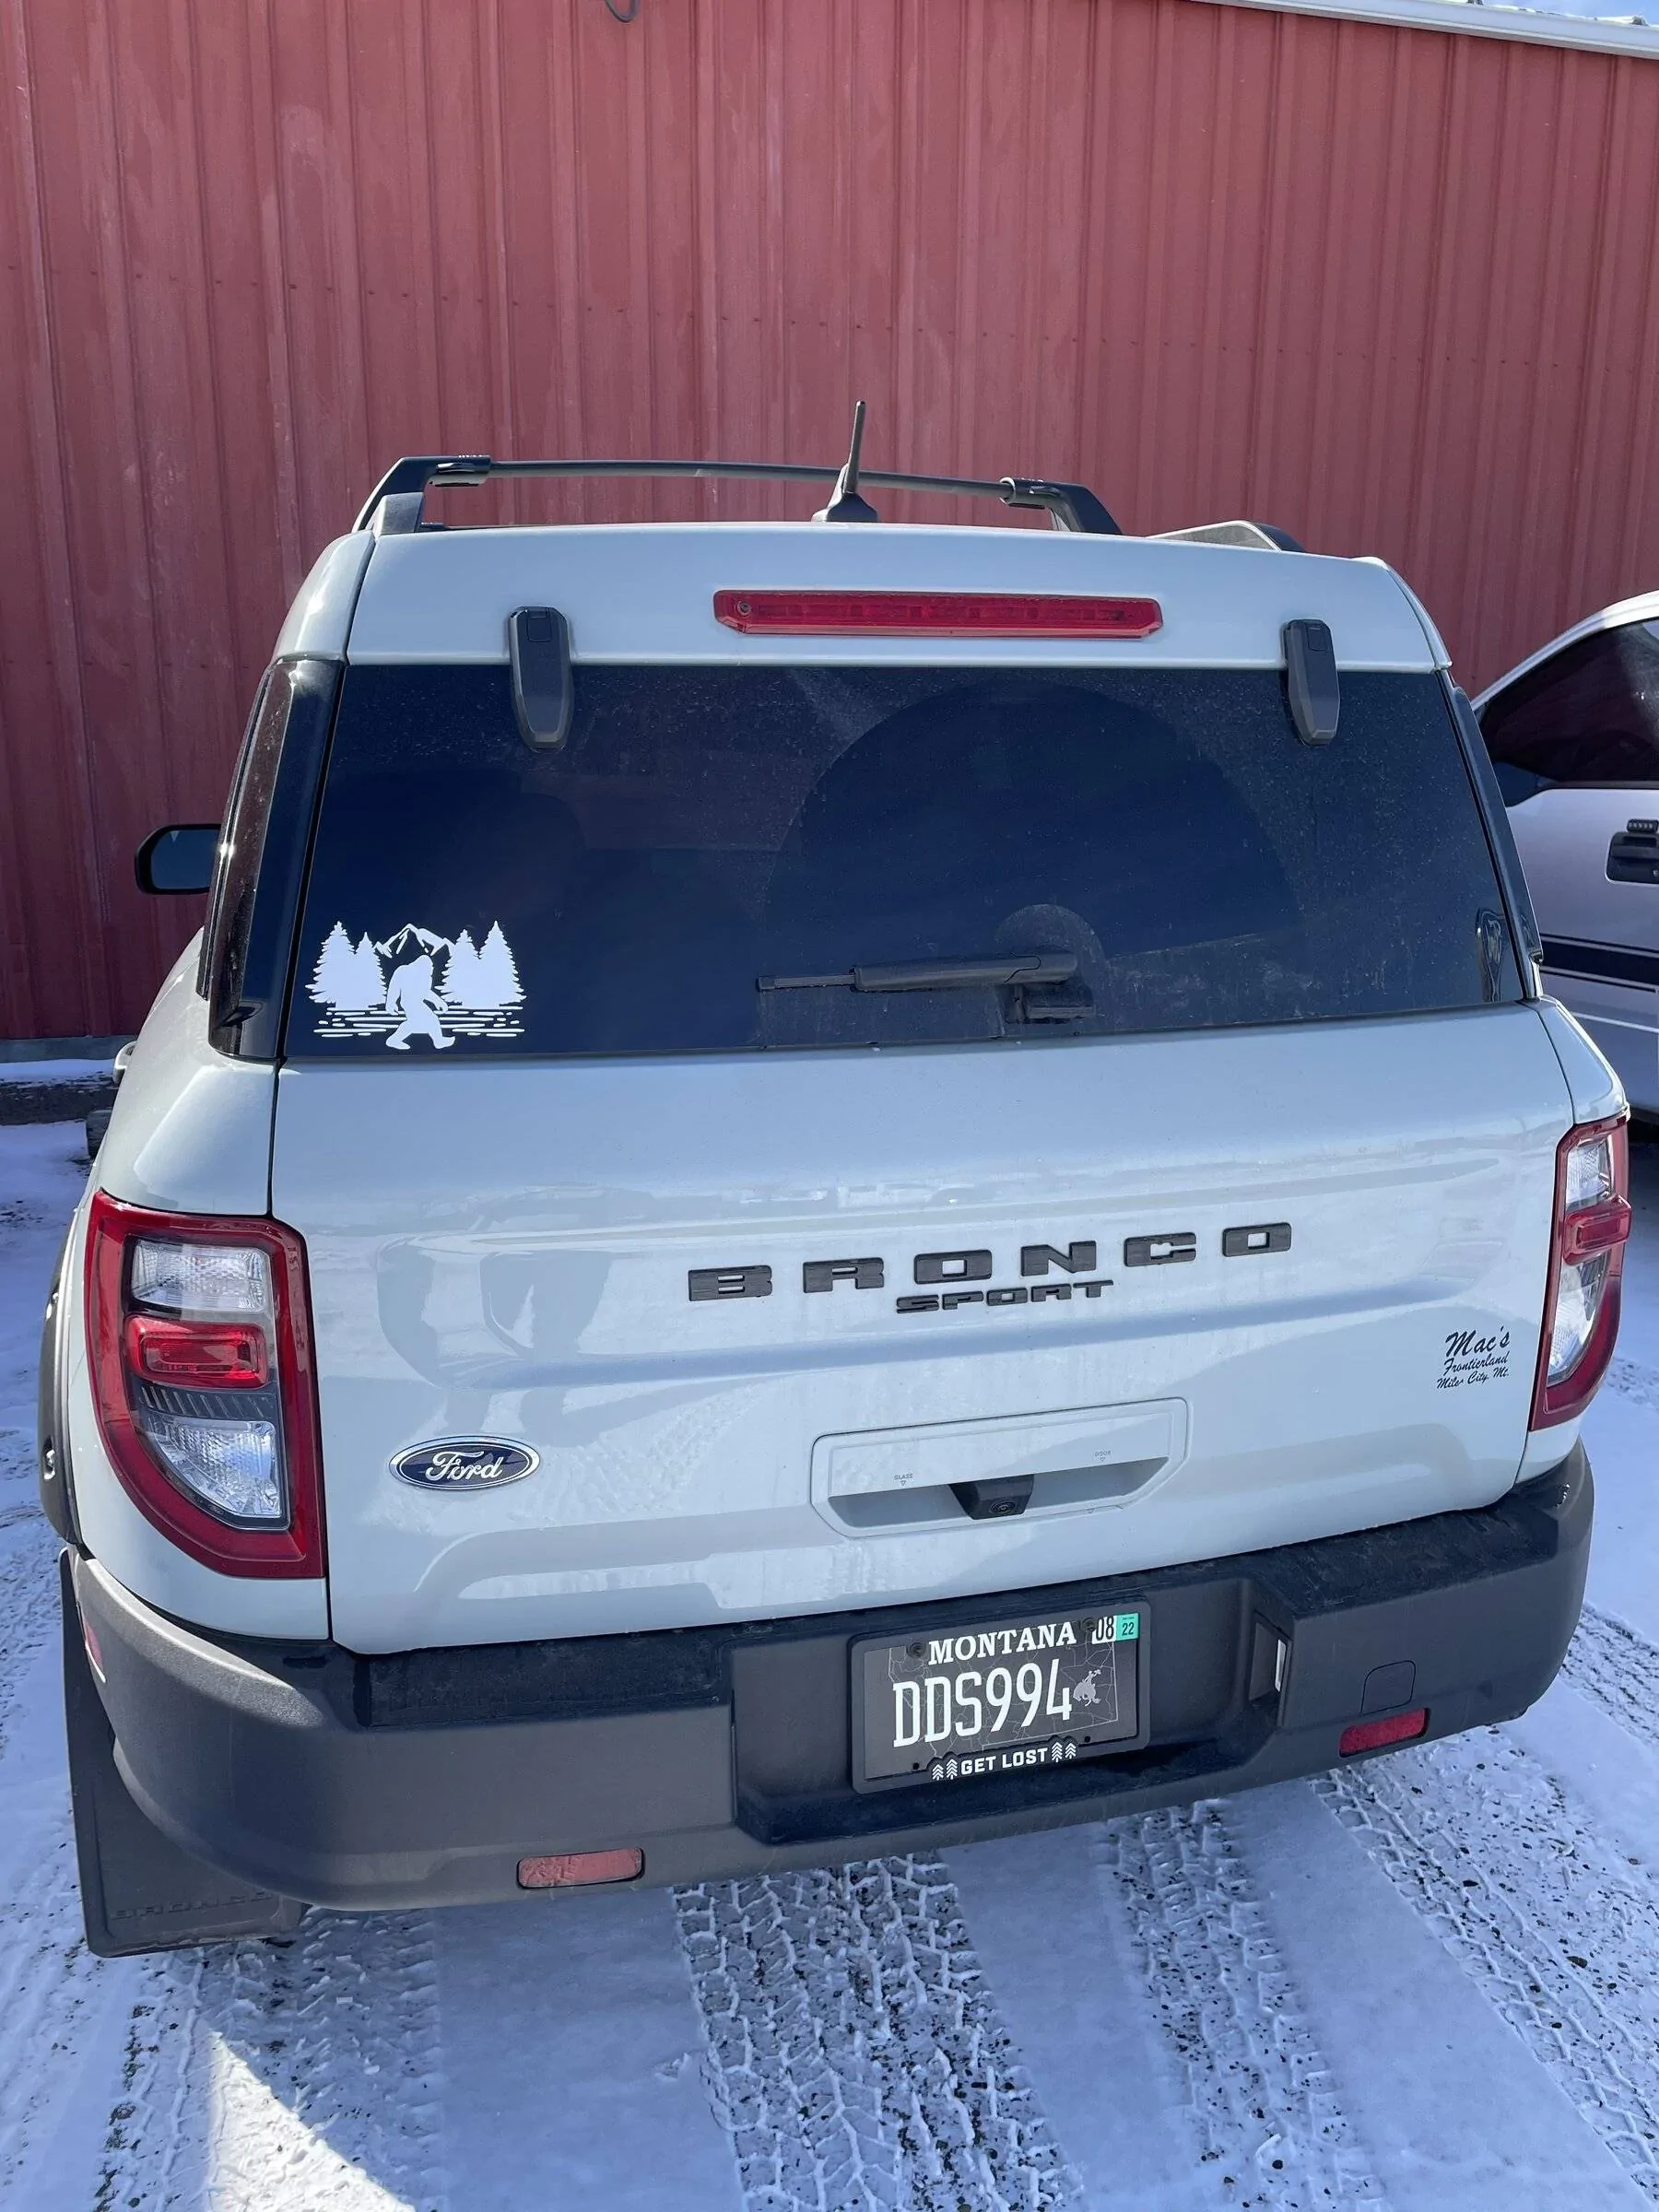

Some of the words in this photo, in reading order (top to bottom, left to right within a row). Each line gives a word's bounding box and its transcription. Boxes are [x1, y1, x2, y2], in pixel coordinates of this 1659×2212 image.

[688, 1222, 1291, 1301] BRONCO
[896, 1278, 1114, 1314] SPORT
[1445, 1325, 1511, 1357] Mac's
[1443, 1350, 1511, 1376] Frontierland
[1437, 1376, 1465, 1389] Miles
[425, 1451, 505, 1481] Ford
[928, 1621, 1077, 1665] MONTANA
[1096, 1617, 1114, 1641] 08
[1122, 1622, 1135, 1636] 22
[893, 1659, 1072, 1747] DDS994
[960, 1756, 996, 1776] GET
[1002, 1747, 1048, 1769] LOST
